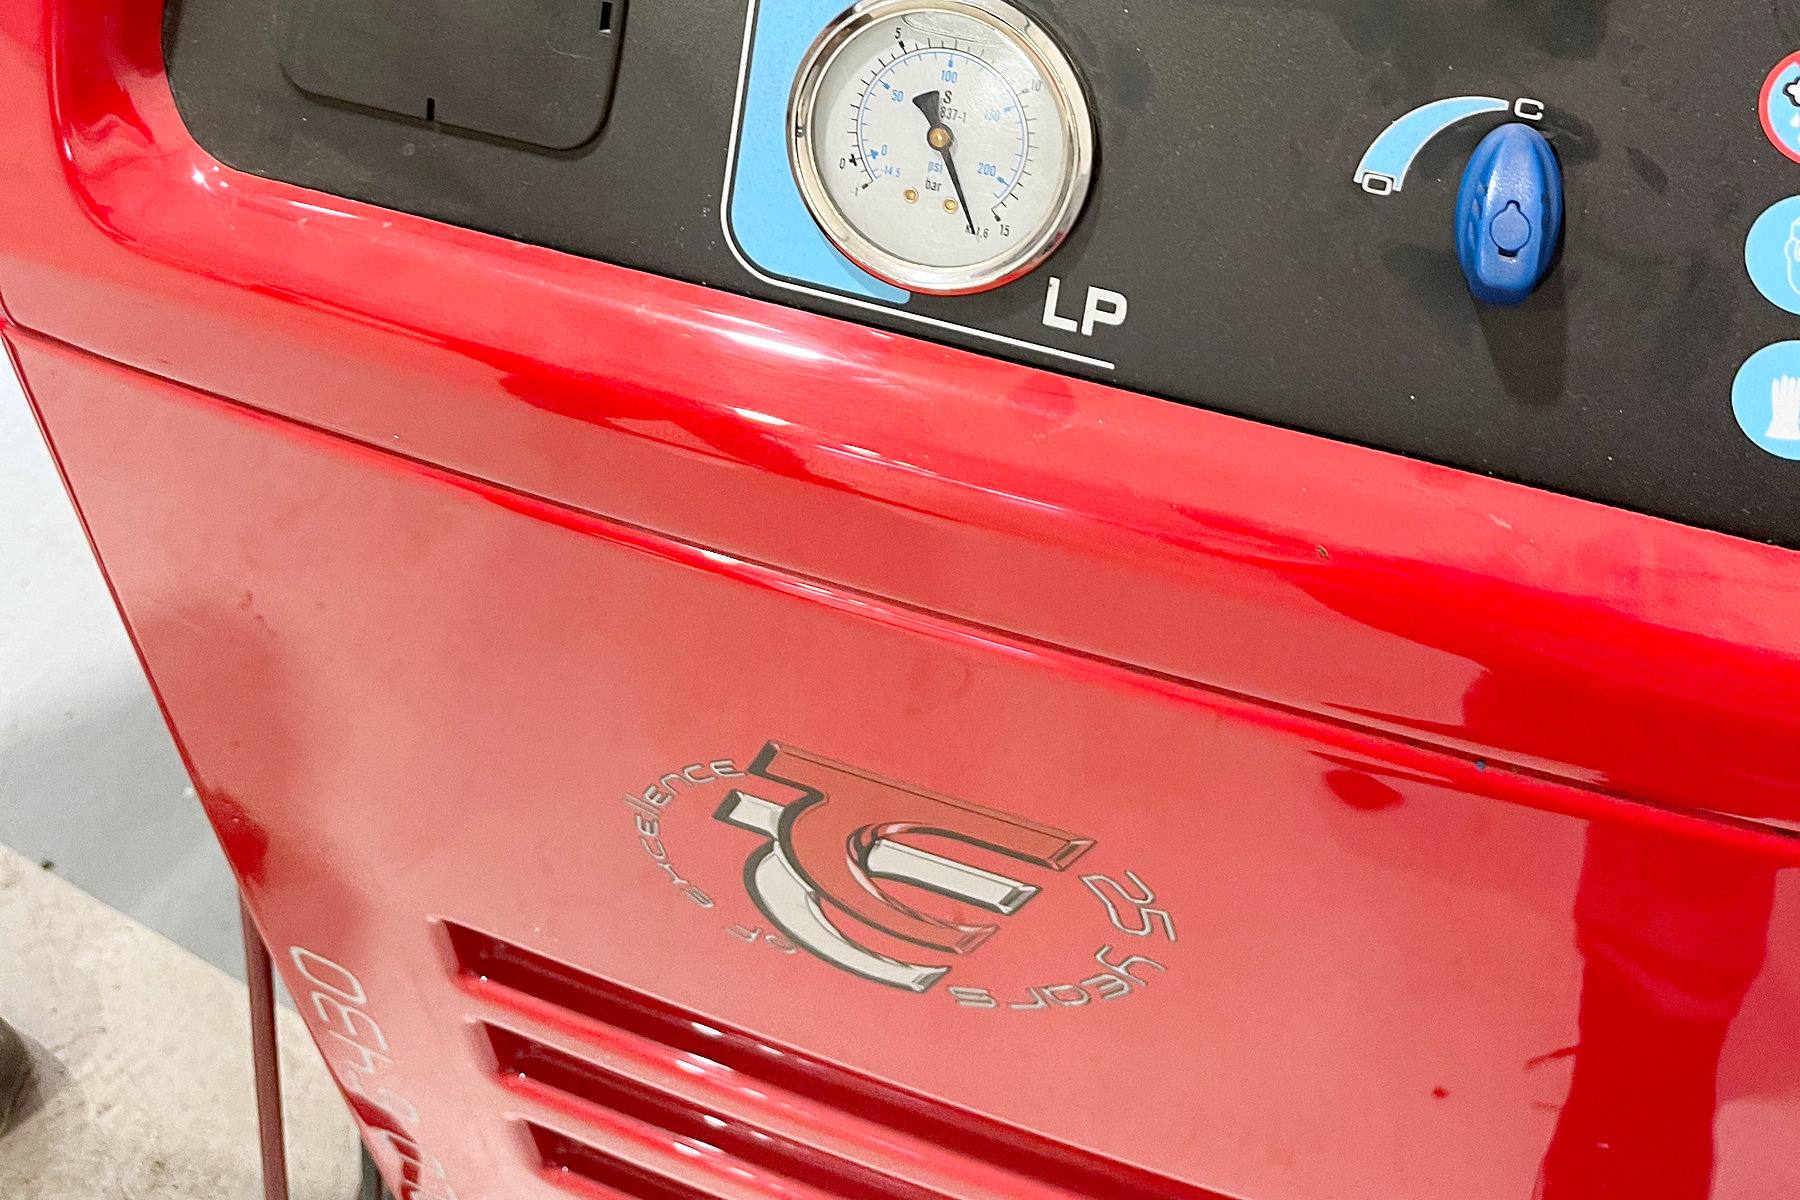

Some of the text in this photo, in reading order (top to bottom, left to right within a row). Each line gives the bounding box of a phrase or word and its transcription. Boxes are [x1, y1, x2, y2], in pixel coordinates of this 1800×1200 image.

[895, 27, 902, 40] 5
[941, 70, 958, 84] 100
[891, 90, 904, 103] 50
[943, 90, 953, 104] S
[881, 144, 888, 156] 0
[839, 158, 846, 169] 0
[977, 162, 997, 177] 200
[925, 177, 942, 192] bar
[1000, 225, 1010, 237] 15
[1042, 276, 1128, 336] LP
[1078, 869, 1178, 944] 25
